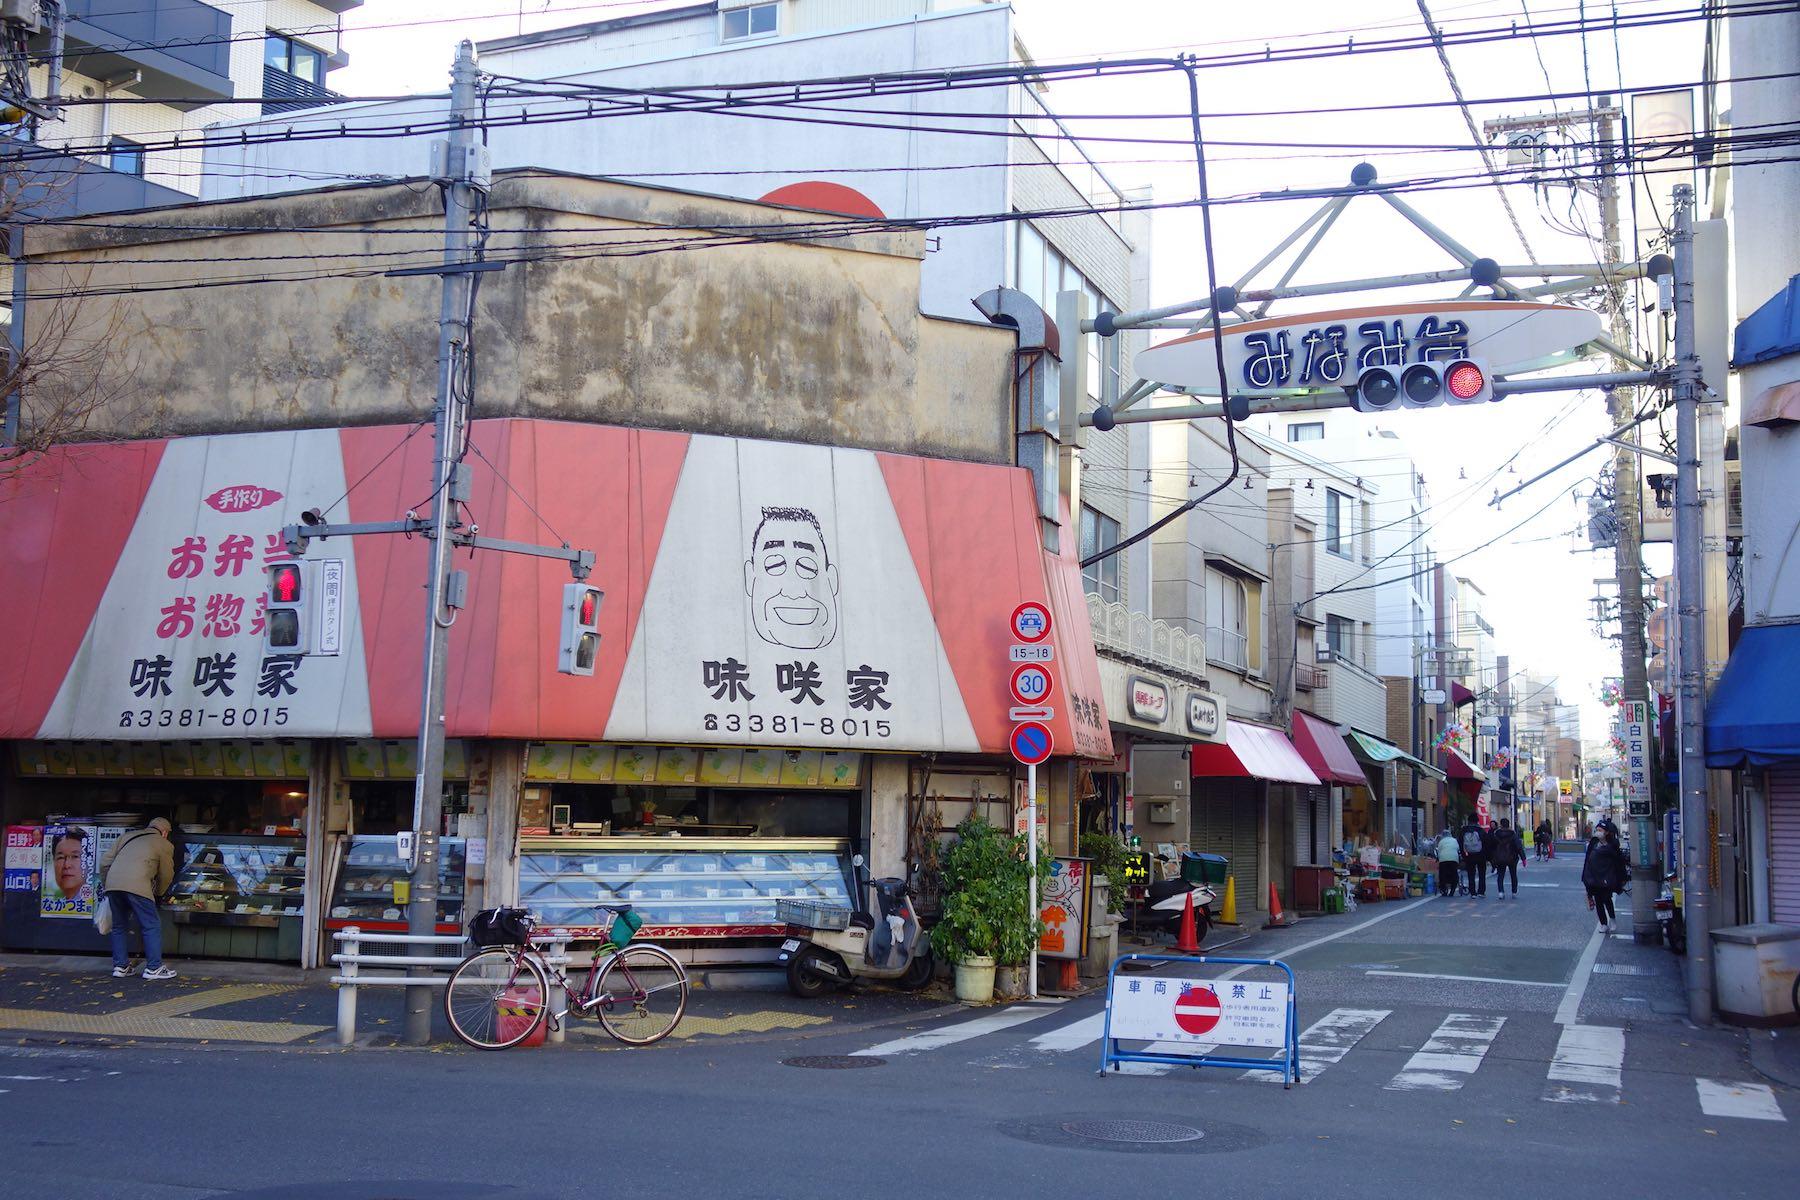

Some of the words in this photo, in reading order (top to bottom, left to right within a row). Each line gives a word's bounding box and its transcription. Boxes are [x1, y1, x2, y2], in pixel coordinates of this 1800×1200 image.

[1244, 314, 1471, 385] みなみ台
[218, 488, 264, 508] 手作り
[325, 567, 339, 646] 夜間押ボタン式
[1014, 648, 1049, 659] 15-18
[130, 652, 303, 699] 味咲家
[703, 657, 892, 711] 味咲家
[1020, 675, 1044, 693] 30
[138, 707, 289, 728] 3381-8015
[726, 714, 892, 737] 3381-8015
[1629, 724, 1645, 784] 白石医院
[5, 873, 26, 890] 山口
[1068, 861, 1083, 886] 手作り
[1125, 867, 1149, 878] カット
[1040, 905, 1067, 953] 弁当
[1129, 980, 1272, 1000] 車両進入禁止
